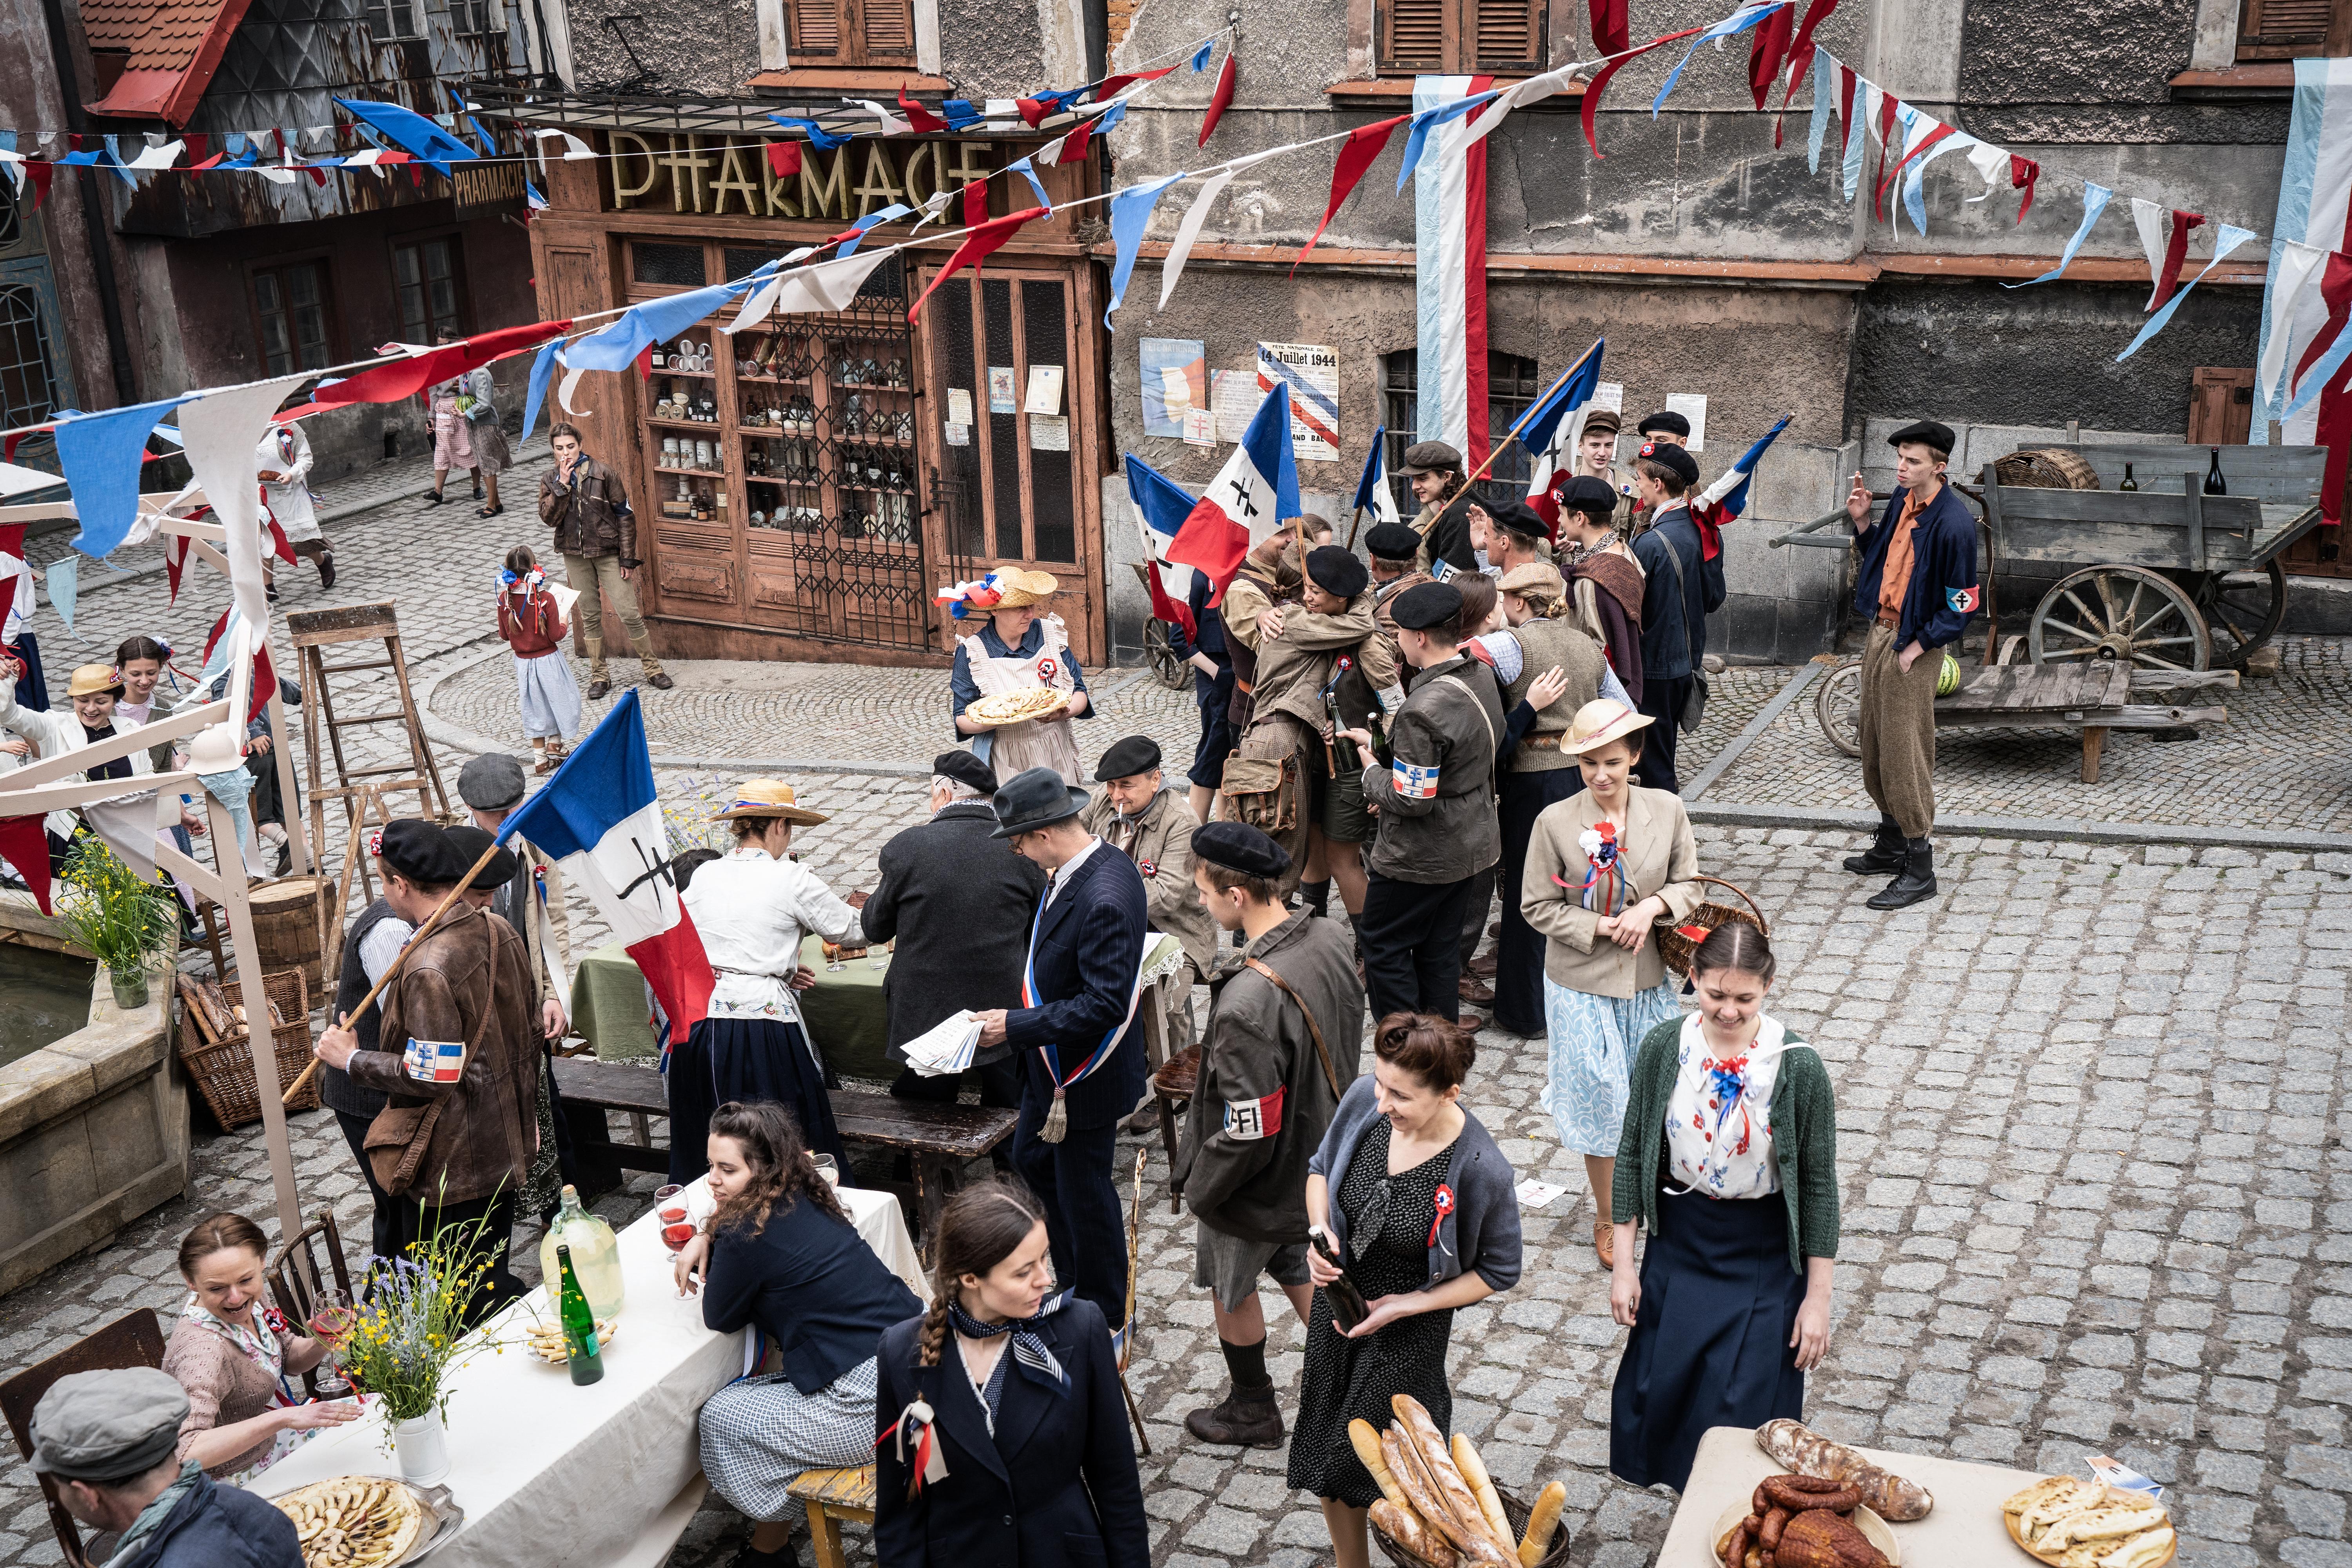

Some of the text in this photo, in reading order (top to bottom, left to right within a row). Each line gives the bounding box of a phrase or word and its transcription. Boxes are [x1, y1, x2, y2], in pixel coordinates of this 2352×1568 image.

[454, 163, 526, 208] PHARMACIE
[608, 130, 996, 225] PHARMACIE
[1163, 344, 1200, 353] NATIONALE
[1261, 350, 1336, 367] 14 Juillet 1944
[1228, 1107, 1258, 1133] FFI
